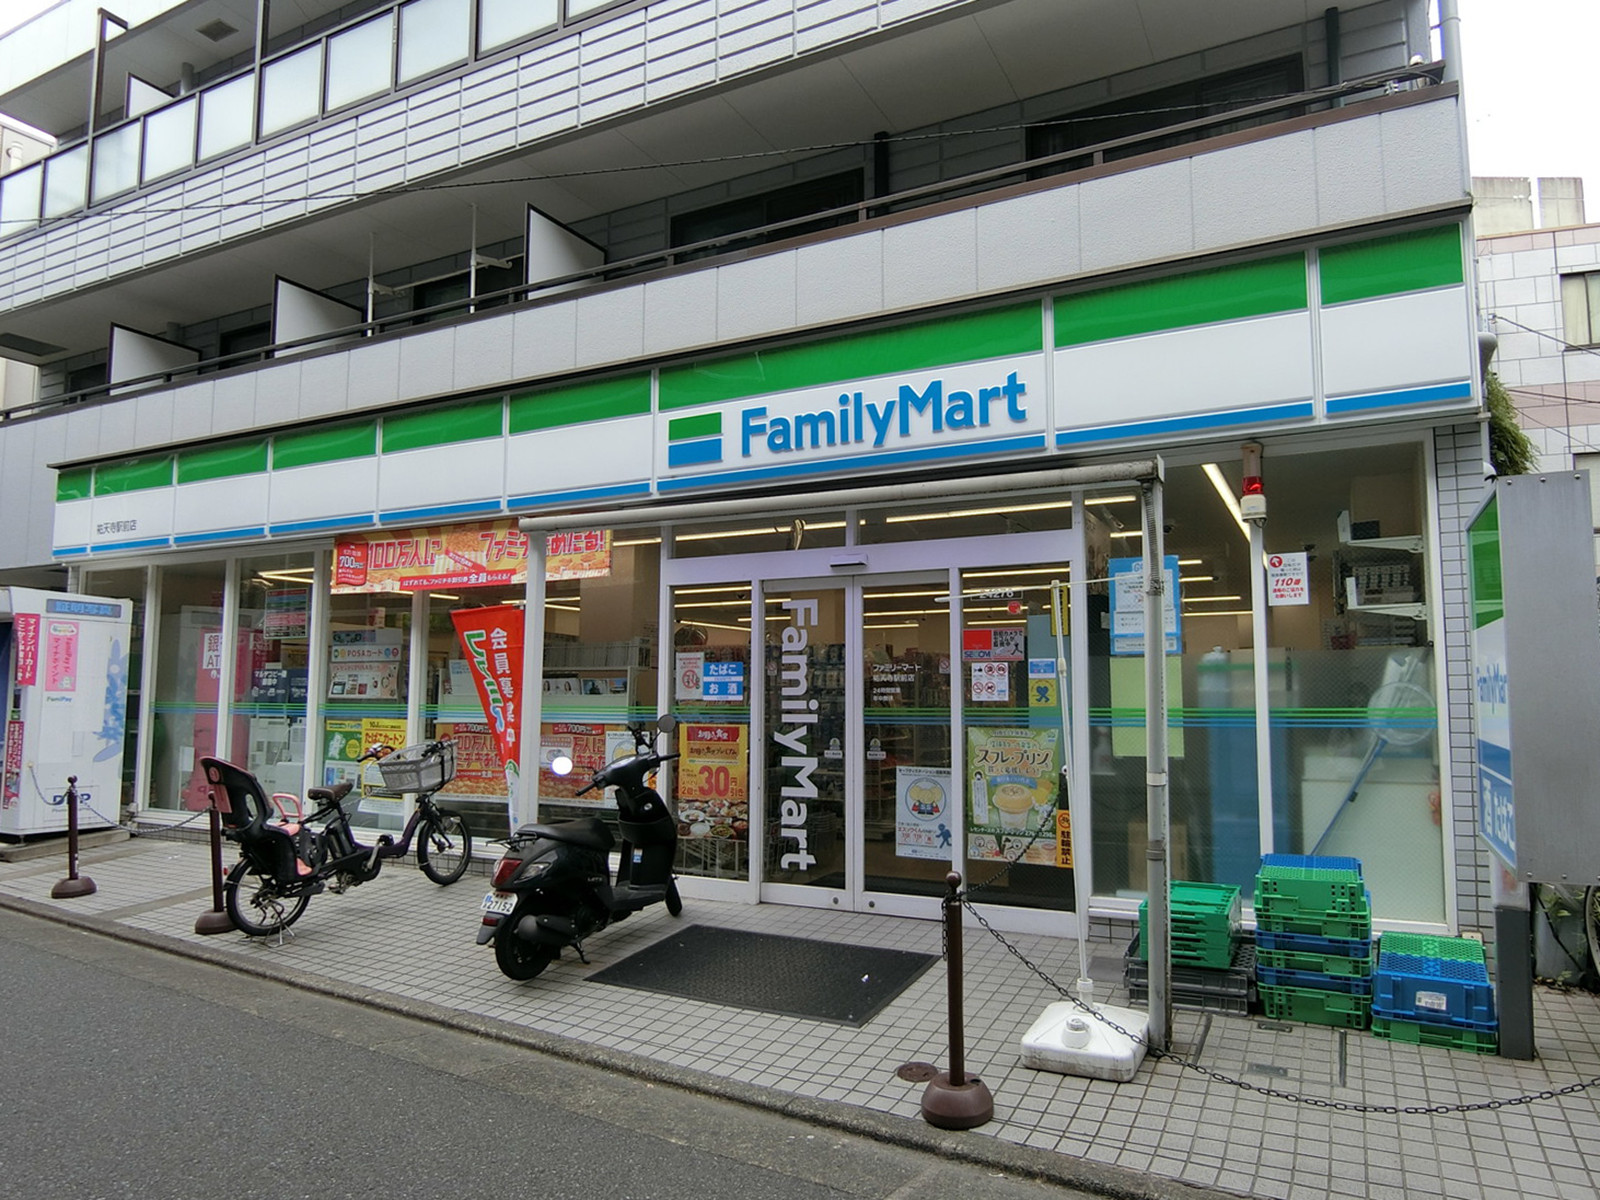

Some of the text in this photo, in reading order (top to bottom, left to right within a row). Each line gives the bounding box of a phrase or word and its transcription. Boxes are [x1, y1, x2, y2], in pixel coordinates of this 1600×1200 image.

[742, 371, 1027, 456] FamilyMart
[368, 538, 442, 570] 100万人に
[1274, 577, 1302, 587] 110番
[347, 649, 384, 657] POSAカード
[206, 655, 223, 668] AT
[873, 663, 922, 672] ファミリーマート
[709, 663, 737, 675] たばこ
[773, 598, 819, 871] FamilyMart
[978, 748, 1049, 765] スフレ・プリン
[698, 765, 730, 797] 30
[53, 793, 91, 805] DP
